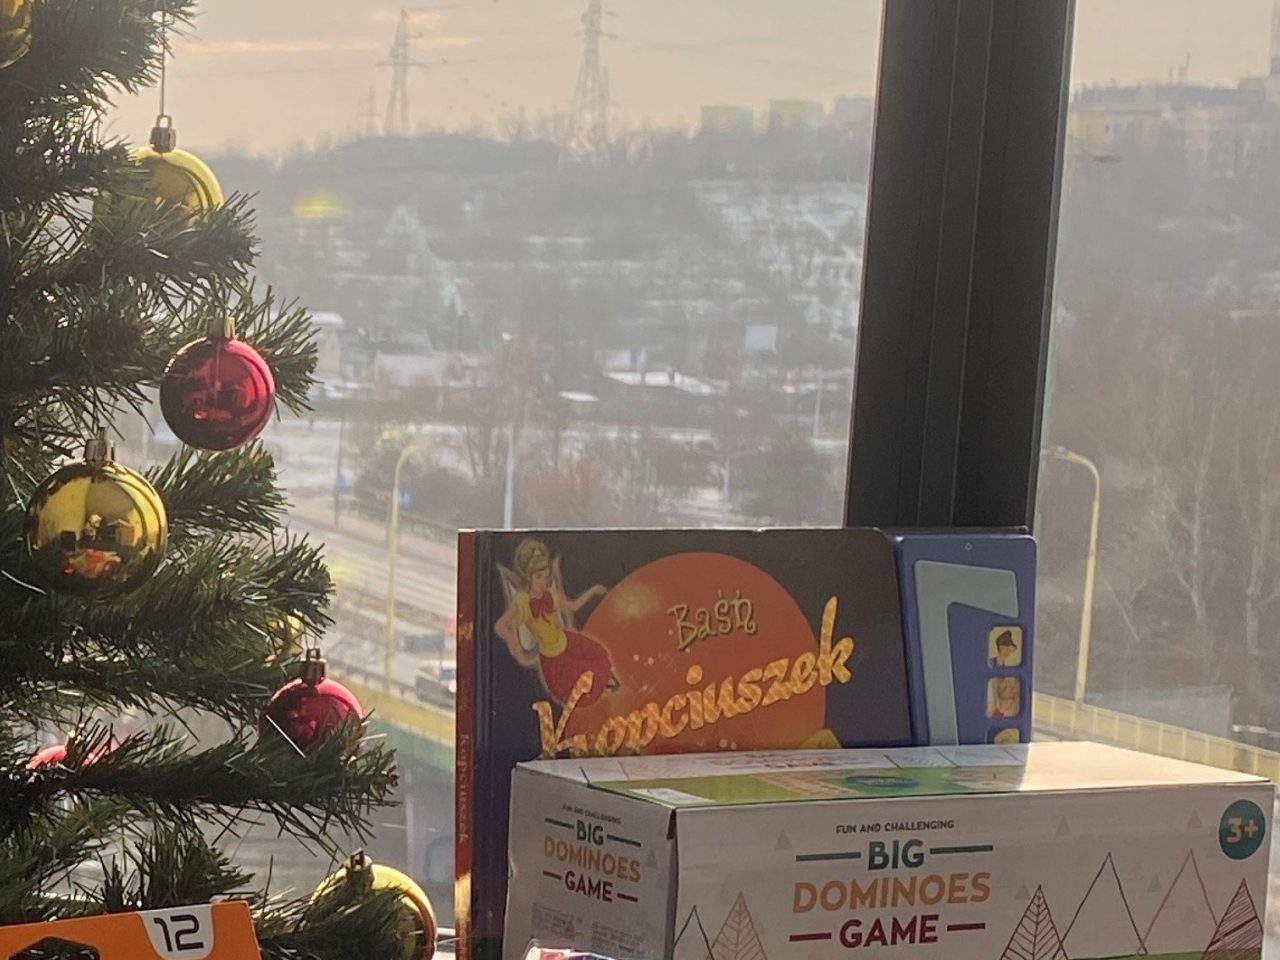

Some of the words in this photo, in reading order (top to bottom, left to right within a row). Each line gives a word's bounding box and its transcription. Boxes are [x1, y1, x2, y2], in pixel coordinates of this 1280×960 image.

[576, 820, 605, 846] BIG
[836, 824, 857, 834] FUN
[860, 823, 881, 833] AND
[884, 820, 955, 832] CHALLENGING
[1227, 816, 1259, 843] 3+
[544, 835, 641, 883] DOMINOES
[868, 839, 925, 871] BIG
[565, 870, 613, 902] GAME
[792, 871, 991, 914] DOMINOES
[153, 914, 205, 953] 12
[839, 914, 939, 949] GAME
